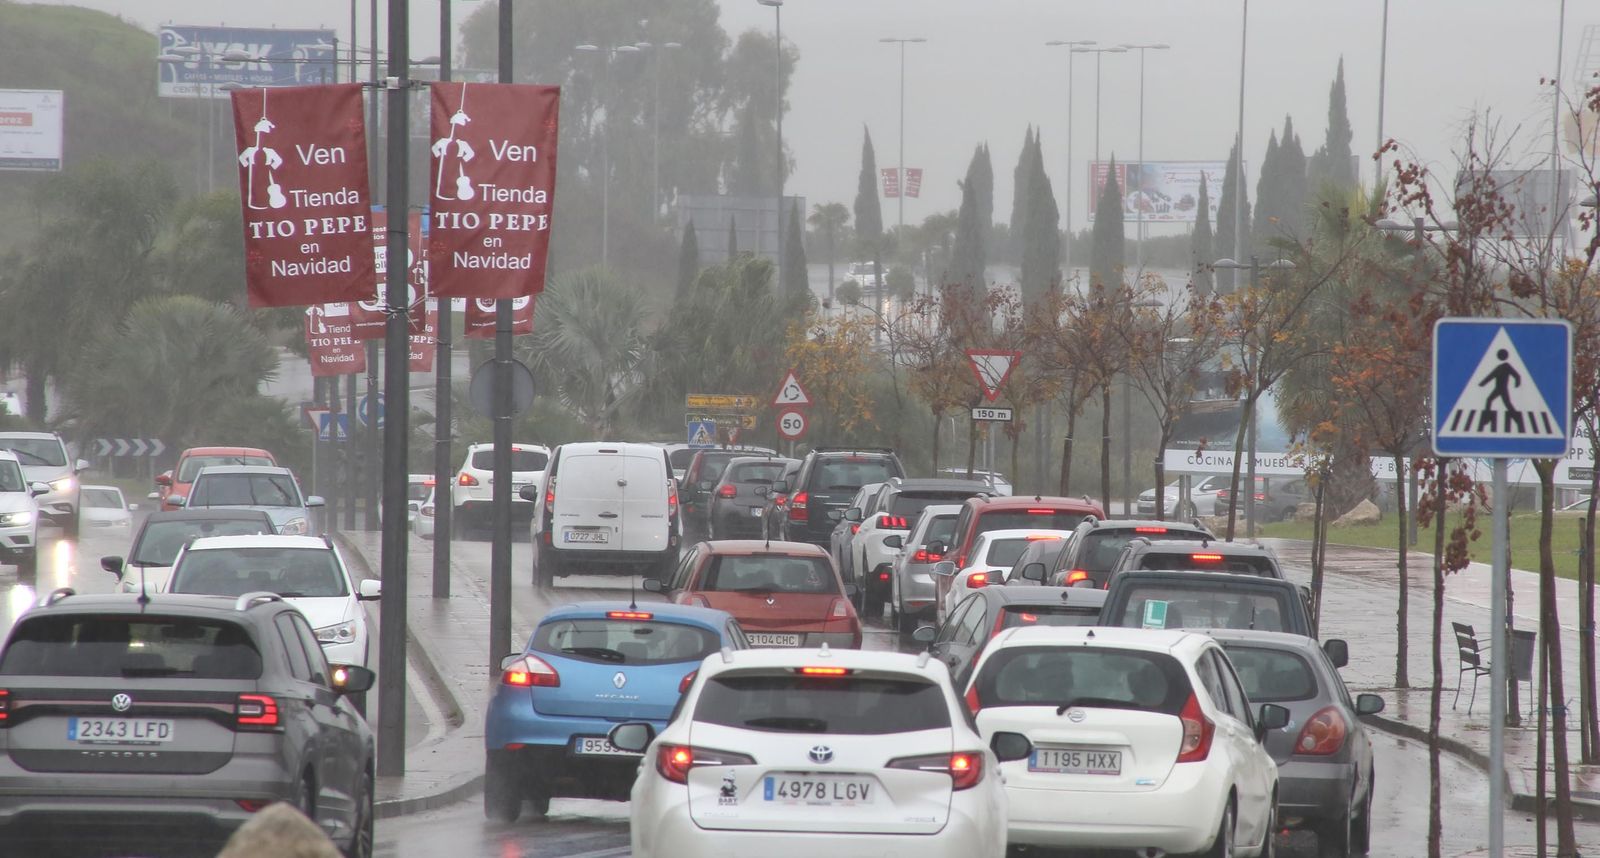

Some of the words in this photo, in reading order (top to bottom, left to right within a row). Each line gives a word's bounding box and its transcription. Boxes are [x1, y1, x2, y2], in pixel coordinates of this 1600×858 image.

[184, 41, 273, 71] JYSK
[296, 143, 346, 166] Ven
[489, 139, 537, 163] Ven
[289, 187, 359, 208] Tienda
[478, 183, 547, 204] Tienda
[249, 219, 295, 239] TIO
[304, 215, 367, 236] PEPE
[435, 211, 480, 229] TIO
[489, 213, 548, 232] PEPE
[300, 242, 320, 254] en
[483, 236, 502, 248] en
[271, 256, 351, 277] Navidad
[453, 252, 531, 269] Navidad
[328, 324, 351, 333] Tiend
[311, 338, 330, 346] TIO
[321, 353, 355, 363] Navidad
[977, 410, 994, 418] 150
[783, 419, 802, 429] 50
[1187, 455, 1233, 467] COCINA
[570, 532, 590, 541] 0727
[591, 533, 605, 541] JHL
[1146, 602, 1163, 624] L
[748, 634, 774, 645] 3104
[776, 635, 796, 646] CHC
[81, 721, 127, 737] 2343
[134, 722, 169, 738] LFD
[1043, 751, 1081, 767] 1195
[1087, 753, 1117, 769] HXX
[777, 780, 826, 799] 4978
[834, 782, 870, 800] LGV
